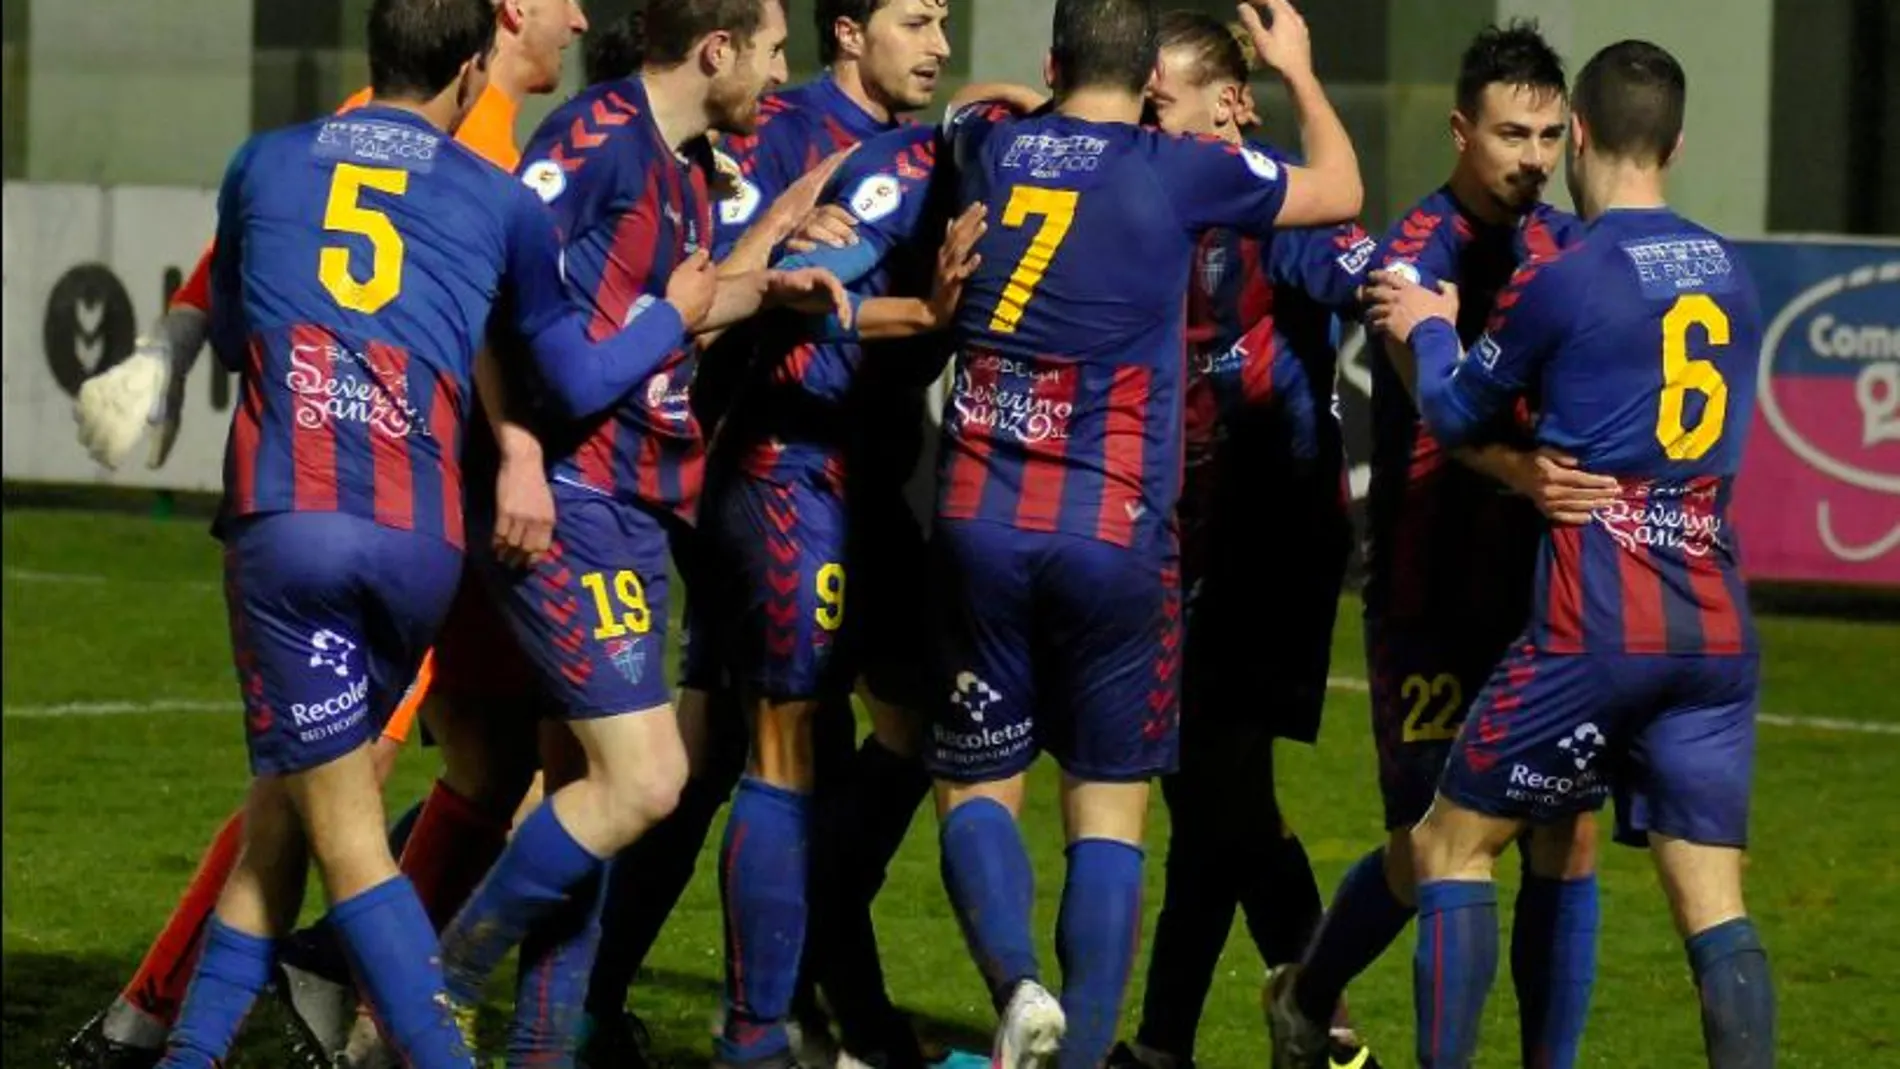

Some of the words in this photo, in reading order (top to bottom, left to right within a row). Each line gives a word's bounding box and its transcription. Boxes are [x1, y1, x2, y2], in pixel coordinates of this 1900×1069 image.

[317, 162, 409, 314] 5
[988, 183, 1080, 334] 7
[1655, 293, 1730, 460] 6
[581, 569, 652, 641] 19
[815, 562, 846, 631] 9
[1401, 673, 1461, 742] 22
